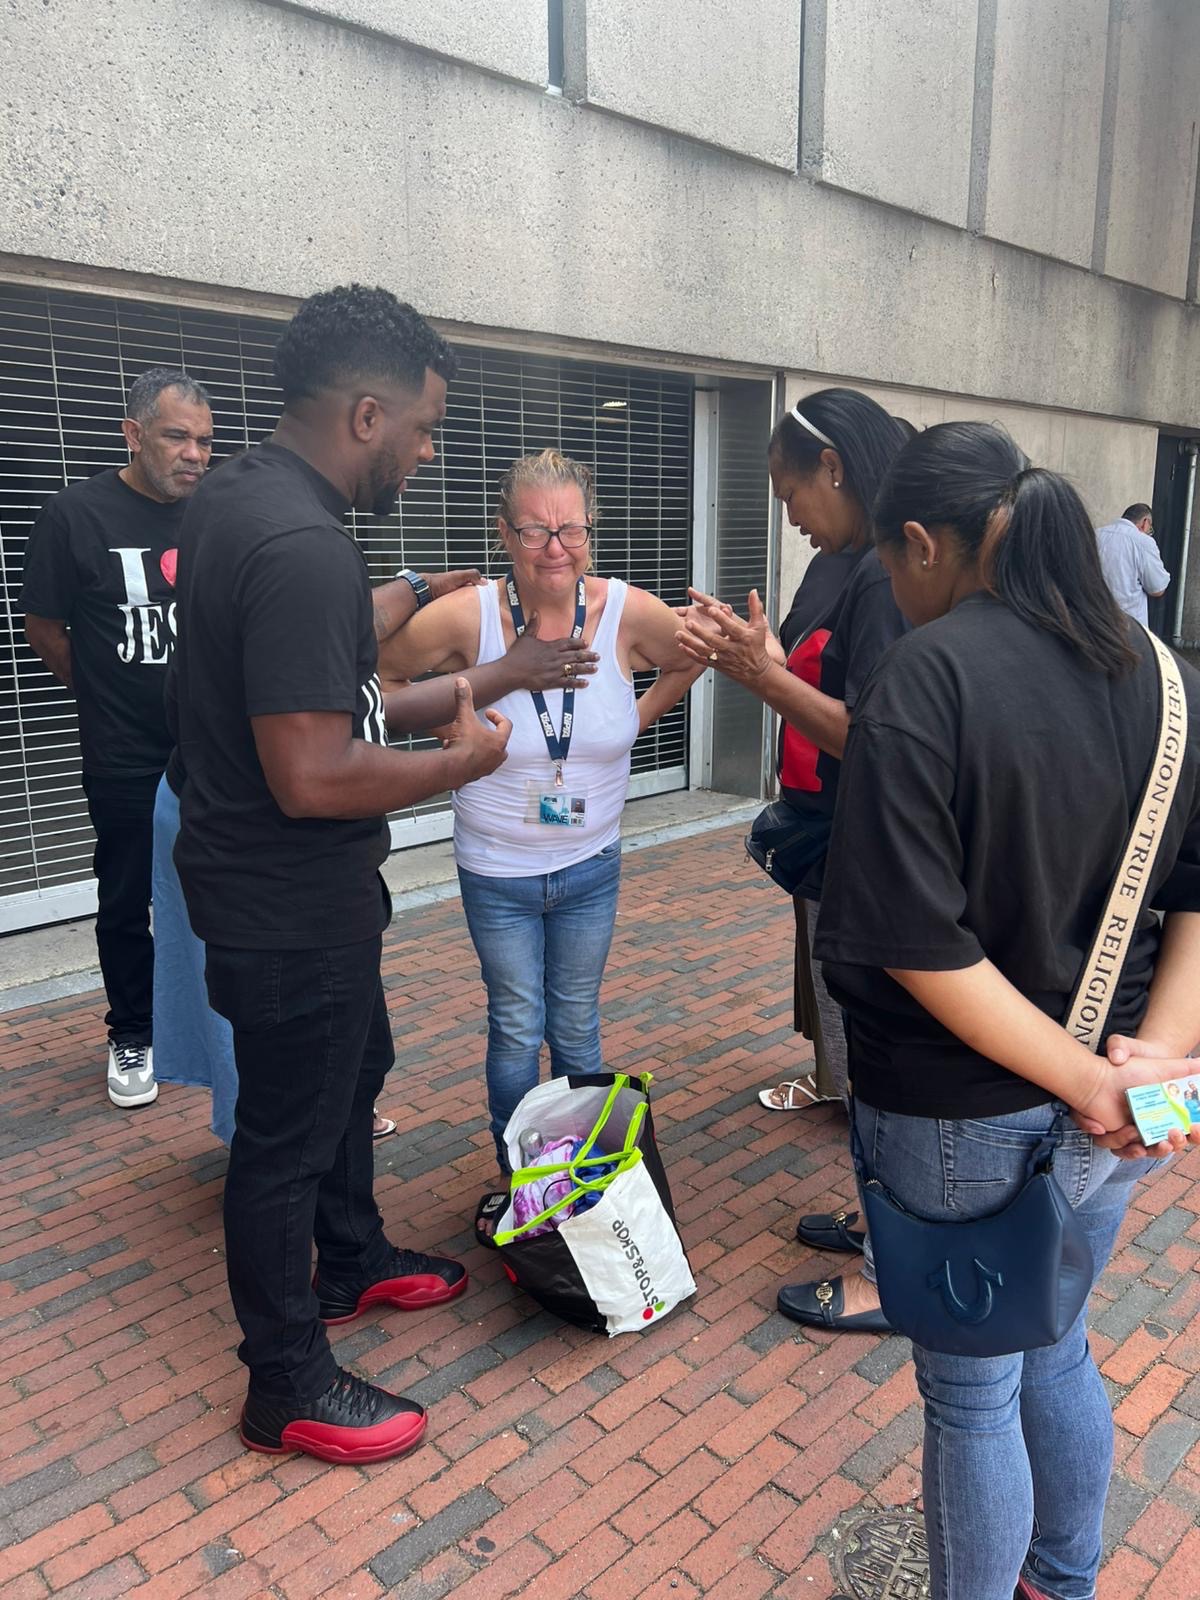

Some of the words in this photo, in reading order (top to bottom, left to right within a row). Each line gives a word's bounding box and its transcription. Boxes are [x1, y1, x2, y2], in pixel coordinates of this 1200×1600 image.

[108, 548, 160, 606] I
[540, 711, 554, 737] RIPTA
[562, 712, 573, 738] RIPTA
[1151, 678, 1182, 803] RELIGION
[543, 813, 569, 824] WAVE
[1119, 830, 1156, 900] TRUE
[1073, 914, 1129, 1046] RELIGION
